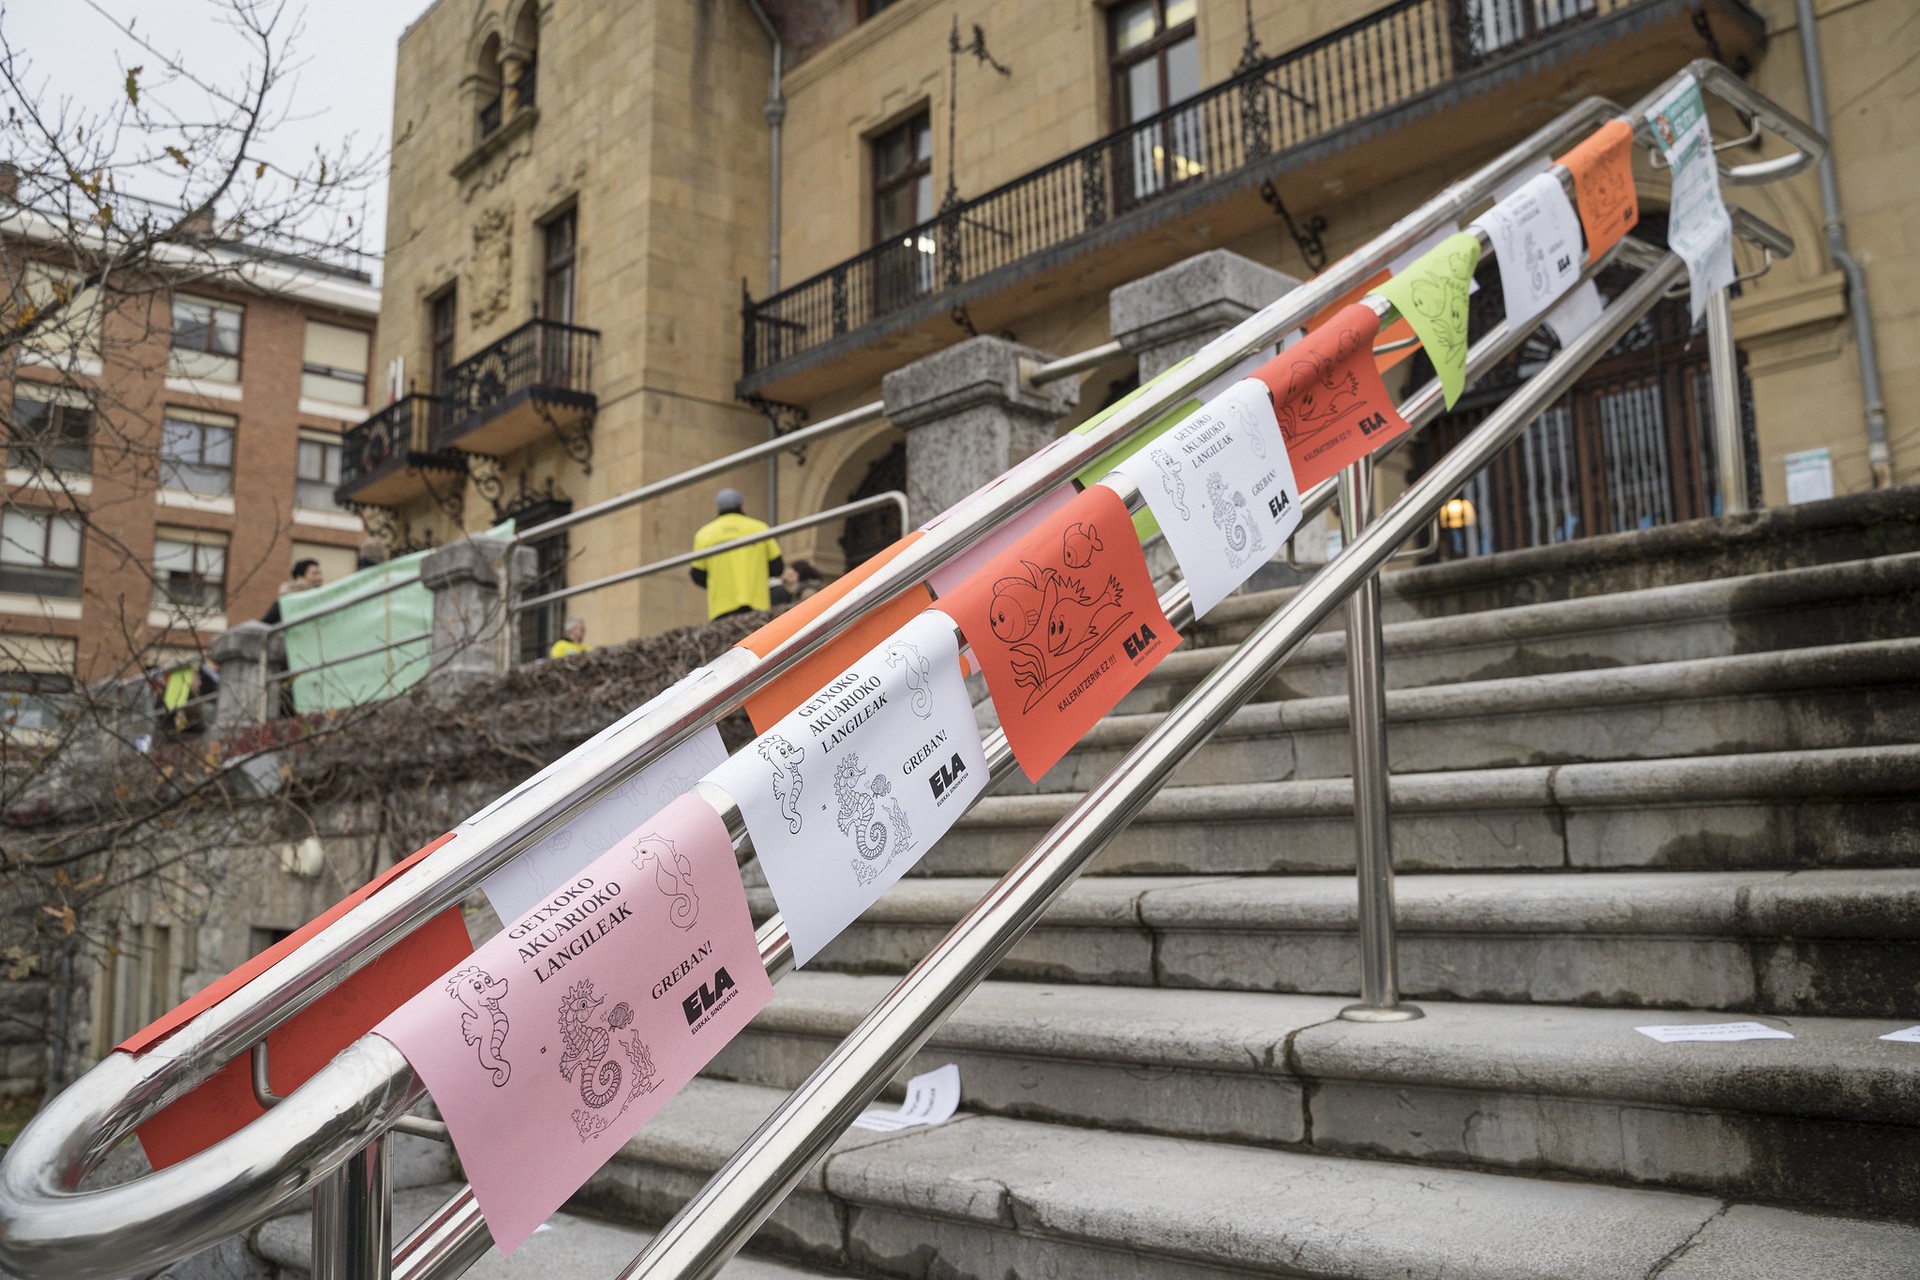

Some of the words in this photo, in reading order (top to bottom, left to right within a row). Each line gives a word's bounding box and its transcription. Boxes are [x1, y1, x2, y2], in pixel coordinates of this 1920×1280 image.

[1173, 414, 1212, 441] GETXOKO
[1182, 421, 1226, 456] AKUARIOKO
[1359, 411, 1388, 436] ELA
[1191, 433, 1234, 468] LANGILEAK
[1268, 489, 1290, 518] ELA
[1122, 623, 1157, 660] ELA
[798, 672, 859, 717] GETXOKO
[809, 676, 882, 737] AKUARIOKO
[1057, 667, 1102, 712] KALERATZERIK
[1100, 660, 1110, 673] EZ
[821, 692, 888, 754] LANGILEAK
[903, 729, 948, 775] GREBAN!
[928, 752, 966, 800] ELA
[508, 877, 595, 940] GETXOKO
[517, 881, 621, 964] AKUARIOKO
[533, 901, 633, 984] LANGILEAK
[651, 940, 713, 1000] GREBAN!
[682, 966, 736, 1027] ELA
[691, 1015, 711, 1035] EUSKAL
[710, 988, 739, 1018] SINDIKATUA
